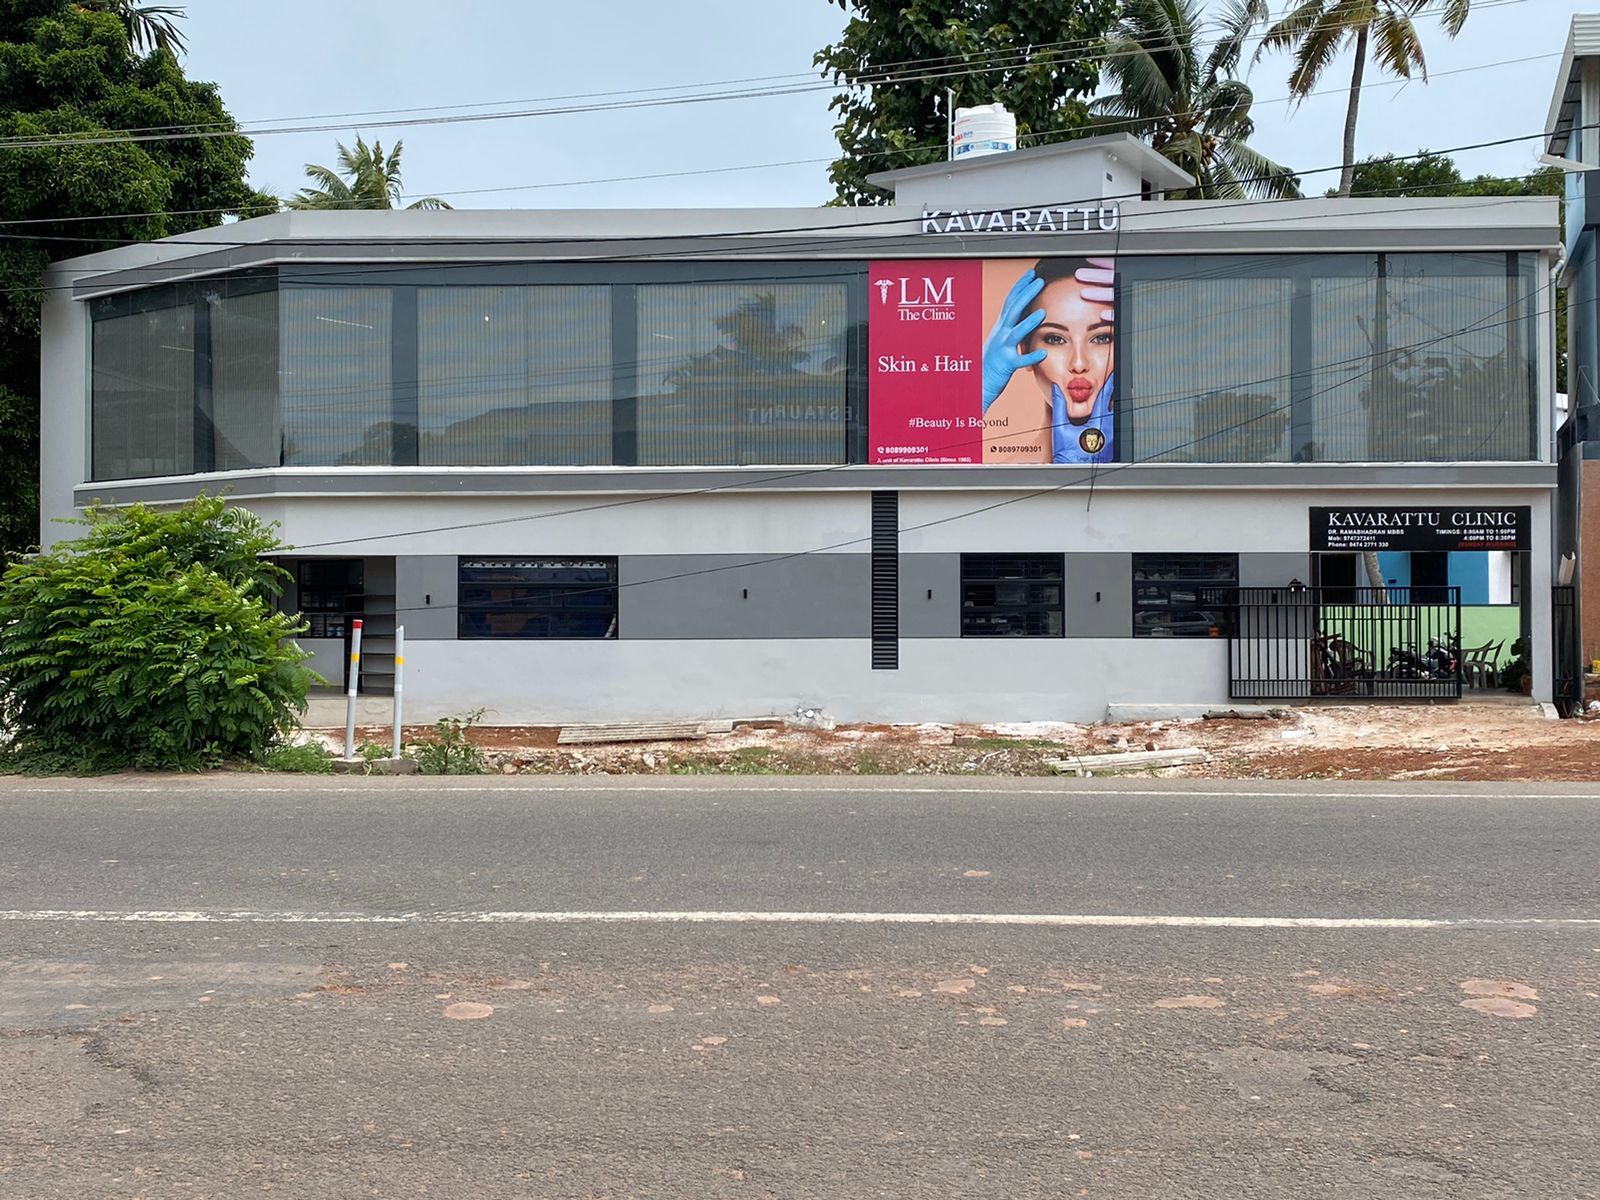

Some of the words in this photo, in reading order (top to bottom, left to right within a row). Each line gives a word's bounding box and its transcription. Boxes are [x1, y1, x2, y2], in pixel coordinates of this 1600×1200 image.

[921, 206, 1120, 233] KAVARATTU
[898, 277, 955, 304] LM
[898, 308, 920, 321] The
[921, 308, 955, 321] Clinic
[878, 356, 916, 372] Skin
[920, 363, 929, 372] &
[935, 355, 972, 372] Hair
[908, 417, 952, 431] #Beauty
[955, 418, 965, 428] Is
[968, 417, 1009, 431] Beyond
[998, 445, 1042, 454] 8089709301
[1327, 512, 1441, 526] KAVARATTU
[1451, 512, 1517, 526] CLINIC
